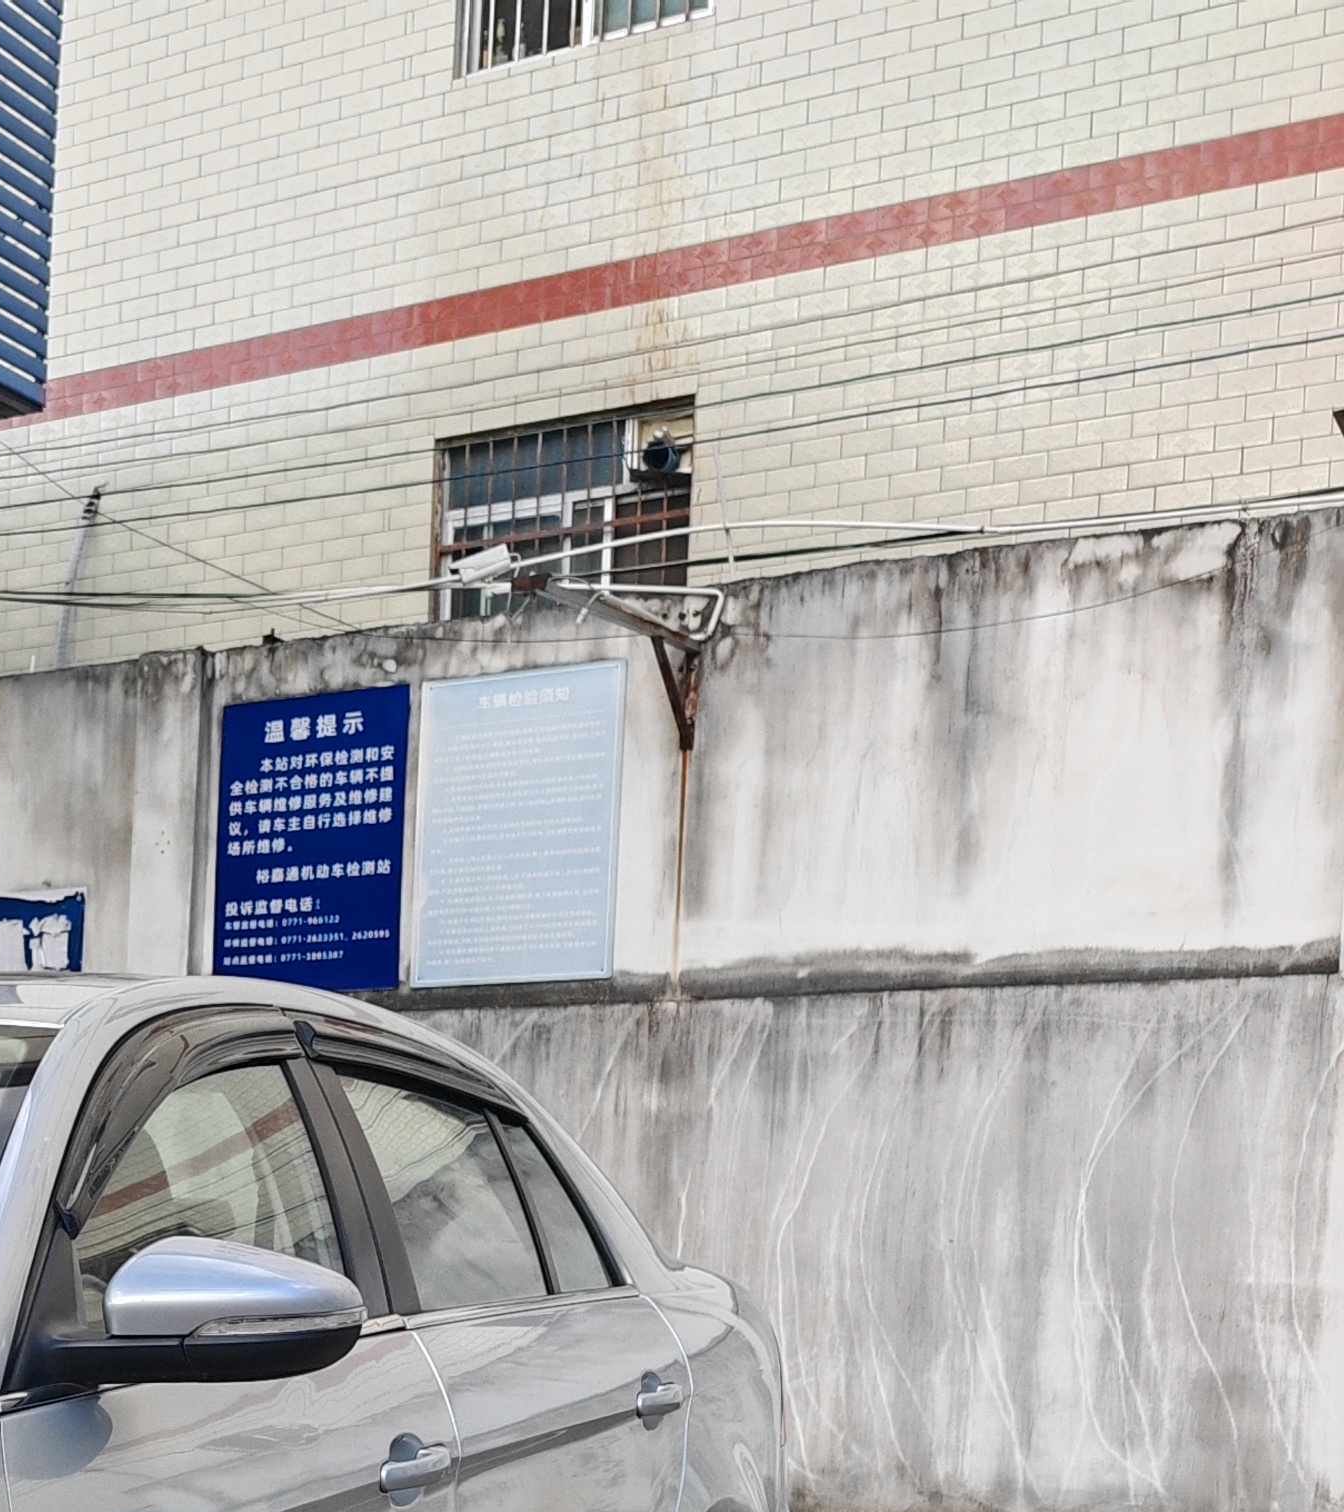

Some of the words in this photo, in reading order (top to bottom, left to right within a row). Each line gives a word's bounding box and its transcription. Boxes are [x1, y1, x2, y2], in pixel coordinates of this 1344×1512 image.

[264, 711, 364, 743] 温馨提示
[260, 745, 395, 773] 本站对环保检测和安
[230, 766, 394, 796] 全检测不合格的车辆不提
[229, 787, 393, 816] 供车辆维修服务及维修建
[228, 807, 392, 836] 议，请车主自行选择维修
[227, 838, 293, 856] 场所维修。
[225, 897, 321, 917] 投诉监督电话：
